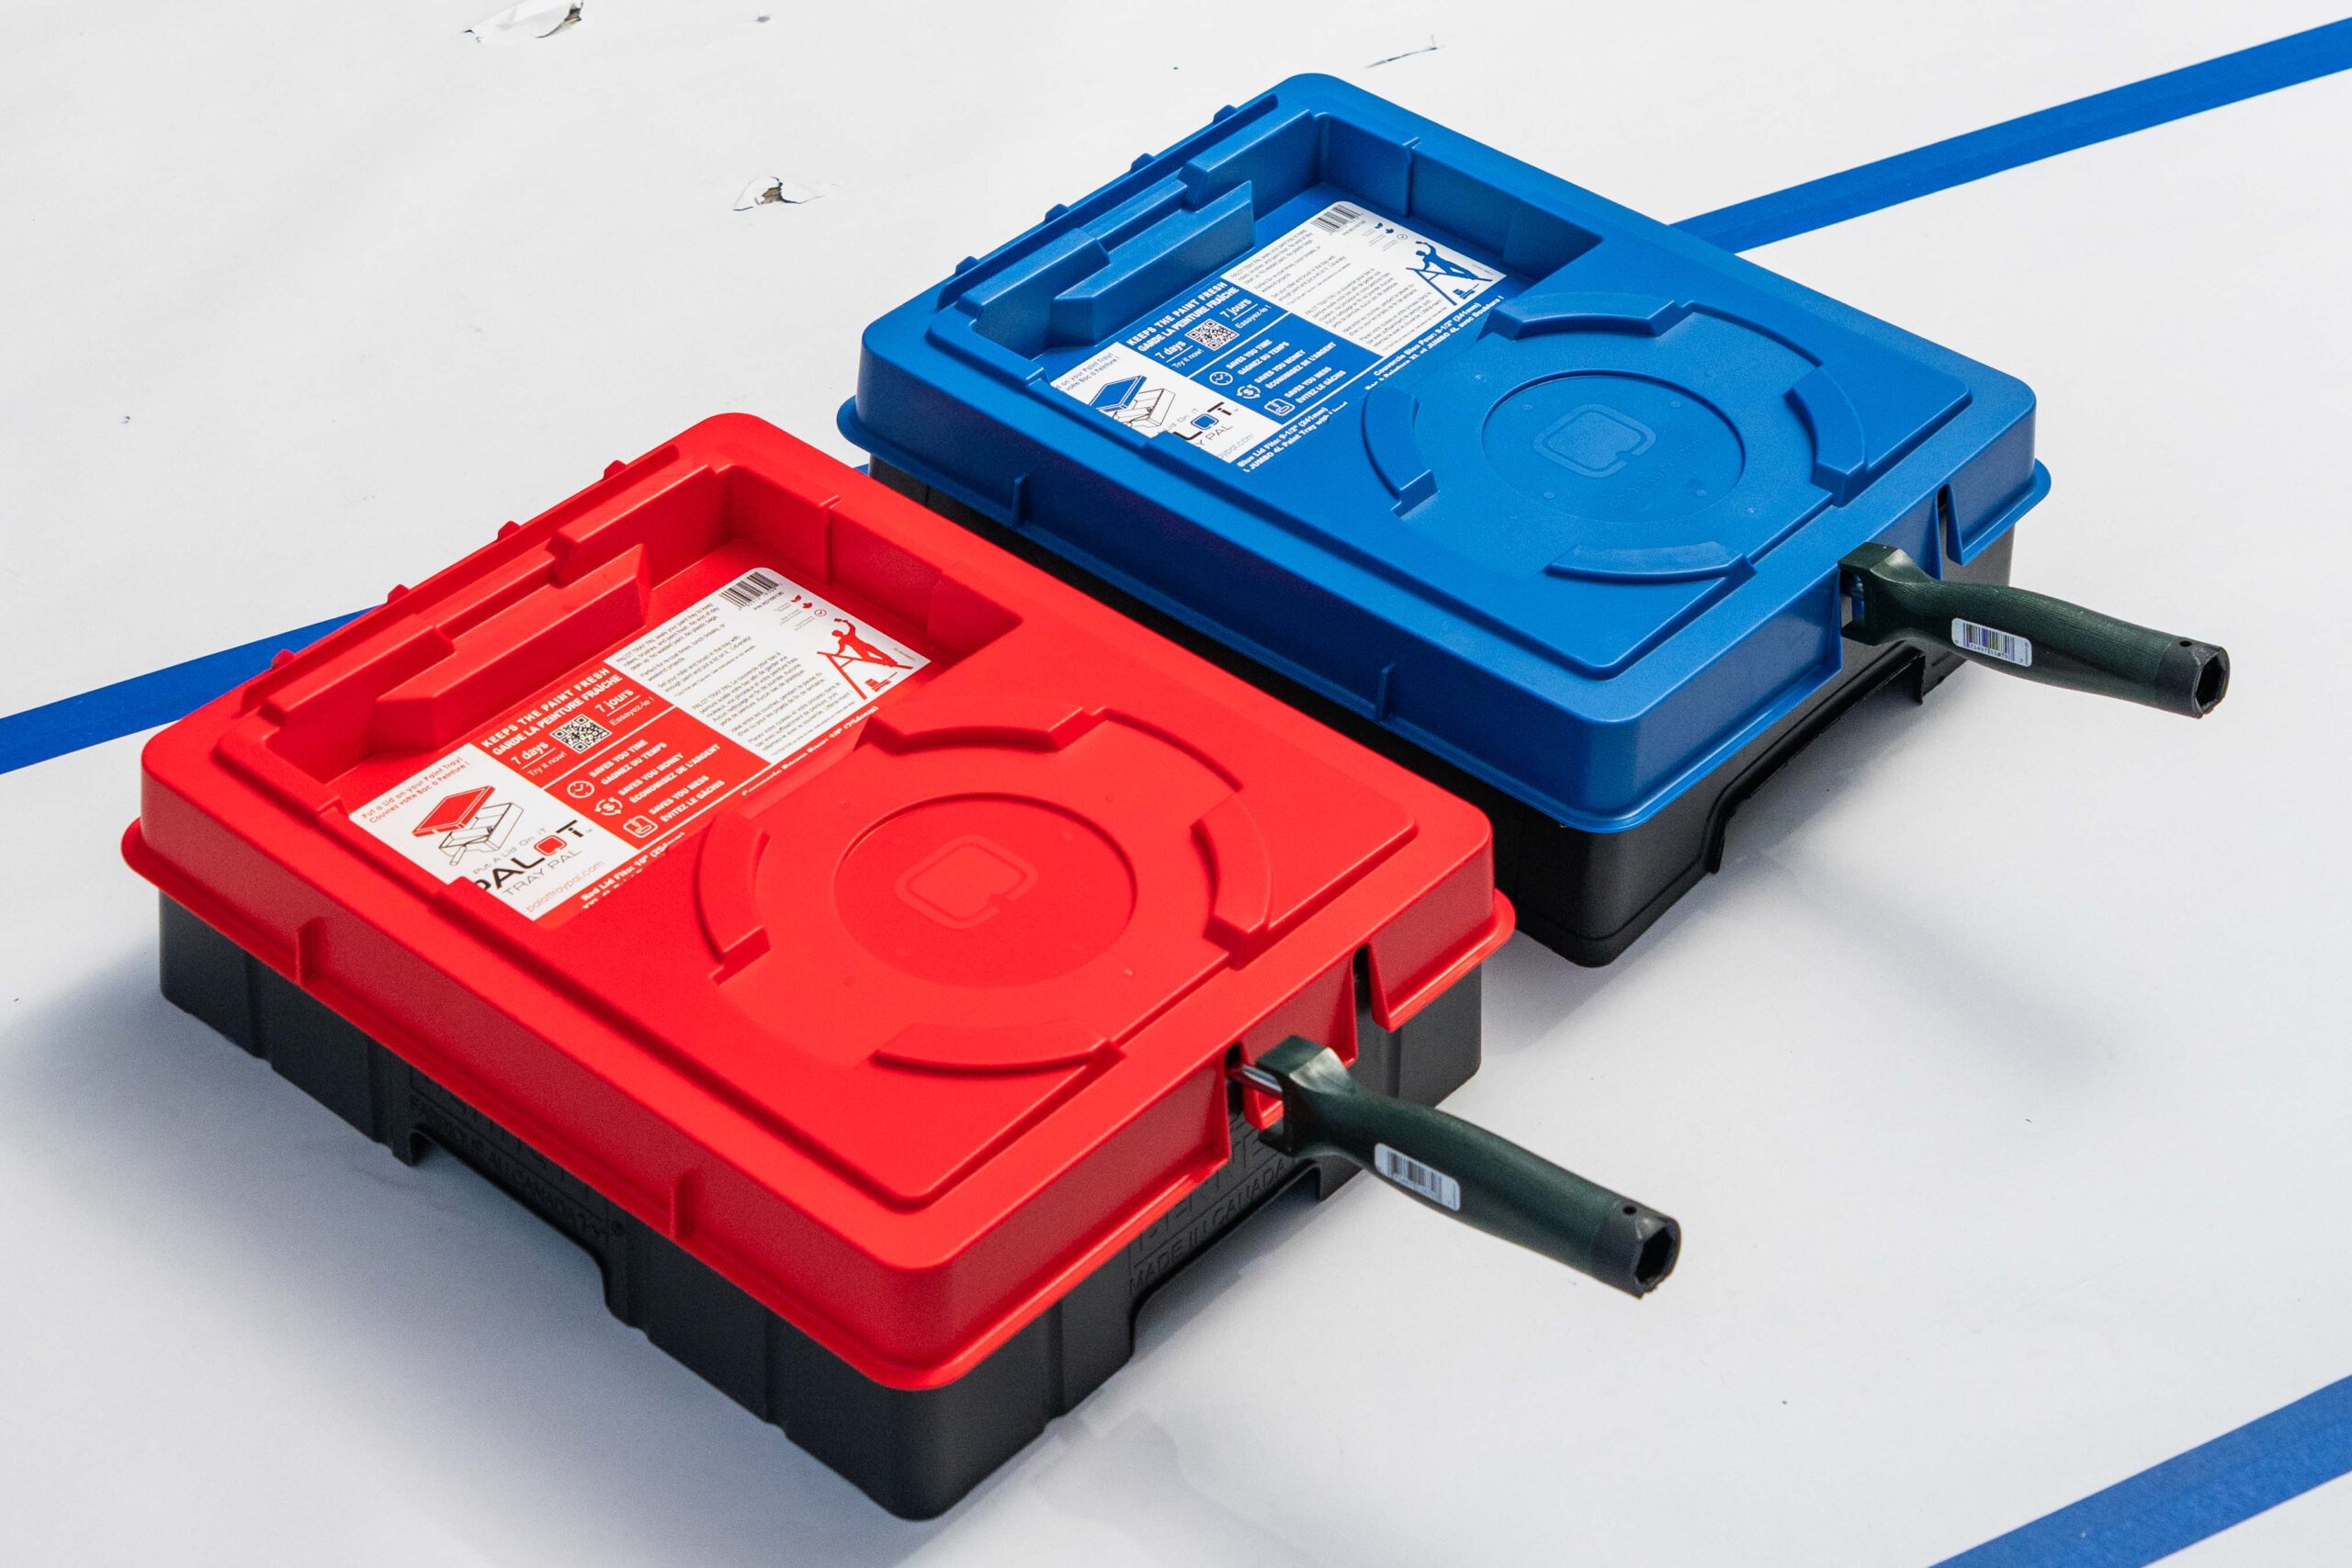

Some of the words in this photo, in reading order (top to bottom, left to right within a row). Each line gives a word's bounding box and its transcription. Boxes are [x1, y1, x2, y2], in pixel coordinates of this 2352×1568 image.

[1125, 326, 1159, 345] KEEPS
[1152, 314, 1177, 328] THE
[1170, 299, 1202, 317] PAINT
[1195, 281, 1229, 300] FRESH
[1136, 333, 1167, 352] GARDE
[1160, 327, 1176, 336] LA
[1170, 305, 1211, 330] PEINTURE
[1203, 286, 1240, 308] FRAÎCHE
[1224, 298, 1256, 315] jours
[1159, 339, 1191, 355] days
[1225, 355, 1248, 369] SAVES
[1242, 348, 1260, 357] YOU
[1253, 338, 1273, 350] TIME
[1235, 455, 1255, 467] Blue
[1251, 447, 1266, 457] Lid
[1261, 437, 1282, 449] Fits:
[1296, 406, 1329, 426] (241mm)
[1247, 451, 1276, 469] JUMBO
[1280, 434, 1302, 446] Paint
[1297, 423, 1318, 435] Tray
[480, 723, 520, 748] KEEPS
[515, 708, 544, 726] THE
[538, 688, 576, 711] PAINT
[571, 667, 611, 691] FRESH
[491, 733, 527, 755] GARDE
[522, 725, 540, 736] LA
[535, 697, 584, 728] PEINTURE
[578, 673, 623, 700] FRAÎCHE
[594, 704, 608, 712] 7
[601, 687, 637, 709] jours
[607, 698, 651, 727] Essayez-le
[509, 756, 525, 765] 7
[517, 739, 552, 761] days
[526, 766, 545, 777] Try
[545, 750, 569, 764] now!
[587, 760, 616, 777] SAVES
[611, 750, 631, 762] YOU
[627, 739, 649, 752] TIME
[599, 763, 633, 784] GAGNEZ
[639, 741, 668, 759] TEMPS
[616, 778, 644, 795] SAVES
[639, 769, 660, 781] YOU
[655, 751, 685, 771] MONEY
[360, 808, 377, 818] Put
[381, 796, 396, 806] Lid
[405, 780, 426, 793] your
[422, 767, 445, 781] Paint
[441, 756, 464, 770] Tray!
[647, 797, 674, 815] SAVES
[671, 787, 690, 799] YOU
[685, 774, 710, 790] MESS
[502, 866, 549, 897] TRAY
[545, 846, 582, 870] PAL
[579, 886, 602, 901] Red
[596, 877, 616, 889] Lid
[611, 864, 636, 880] Fits:
[631, 853, 651, 866] 10"
[1211, 1157, 1285, 1226] CANADA
